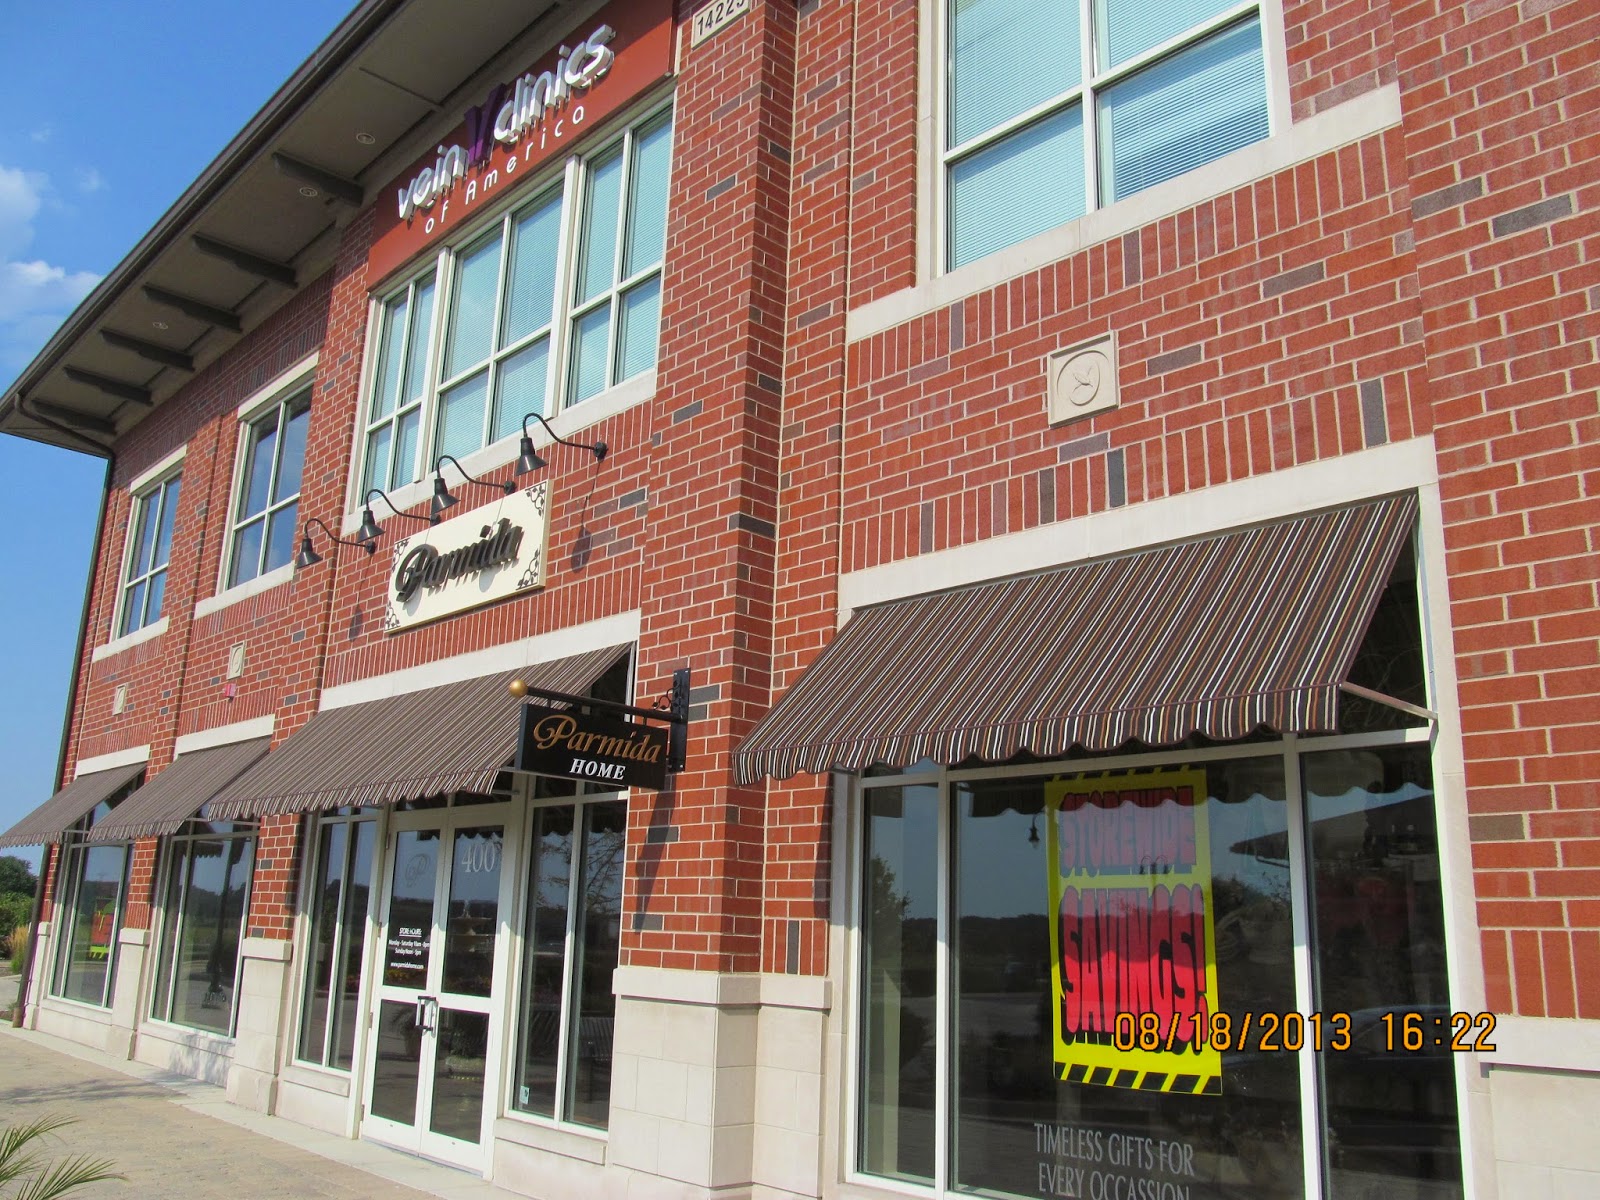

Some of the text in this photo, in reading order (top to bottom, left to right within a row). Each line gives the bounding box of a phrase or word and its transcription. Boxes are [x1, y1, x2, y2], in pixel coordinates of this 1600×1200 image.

[398, 145, 469, 220] vein
[494, 24, 616, 145] clinics
[425, 105, 585, 234] of America
[569, 758, 626, 780] HOME
[462, 842, 495, 873] 400
[1060, 785, 1197, 875] STOREWIDE
[1059, 884, 1208, 1051] SAVINGS!
[1034, 1122, 1195, 1176] TIMELESS GIFTS FOR
[1038, 1162, 1084, 1199] EVERY
